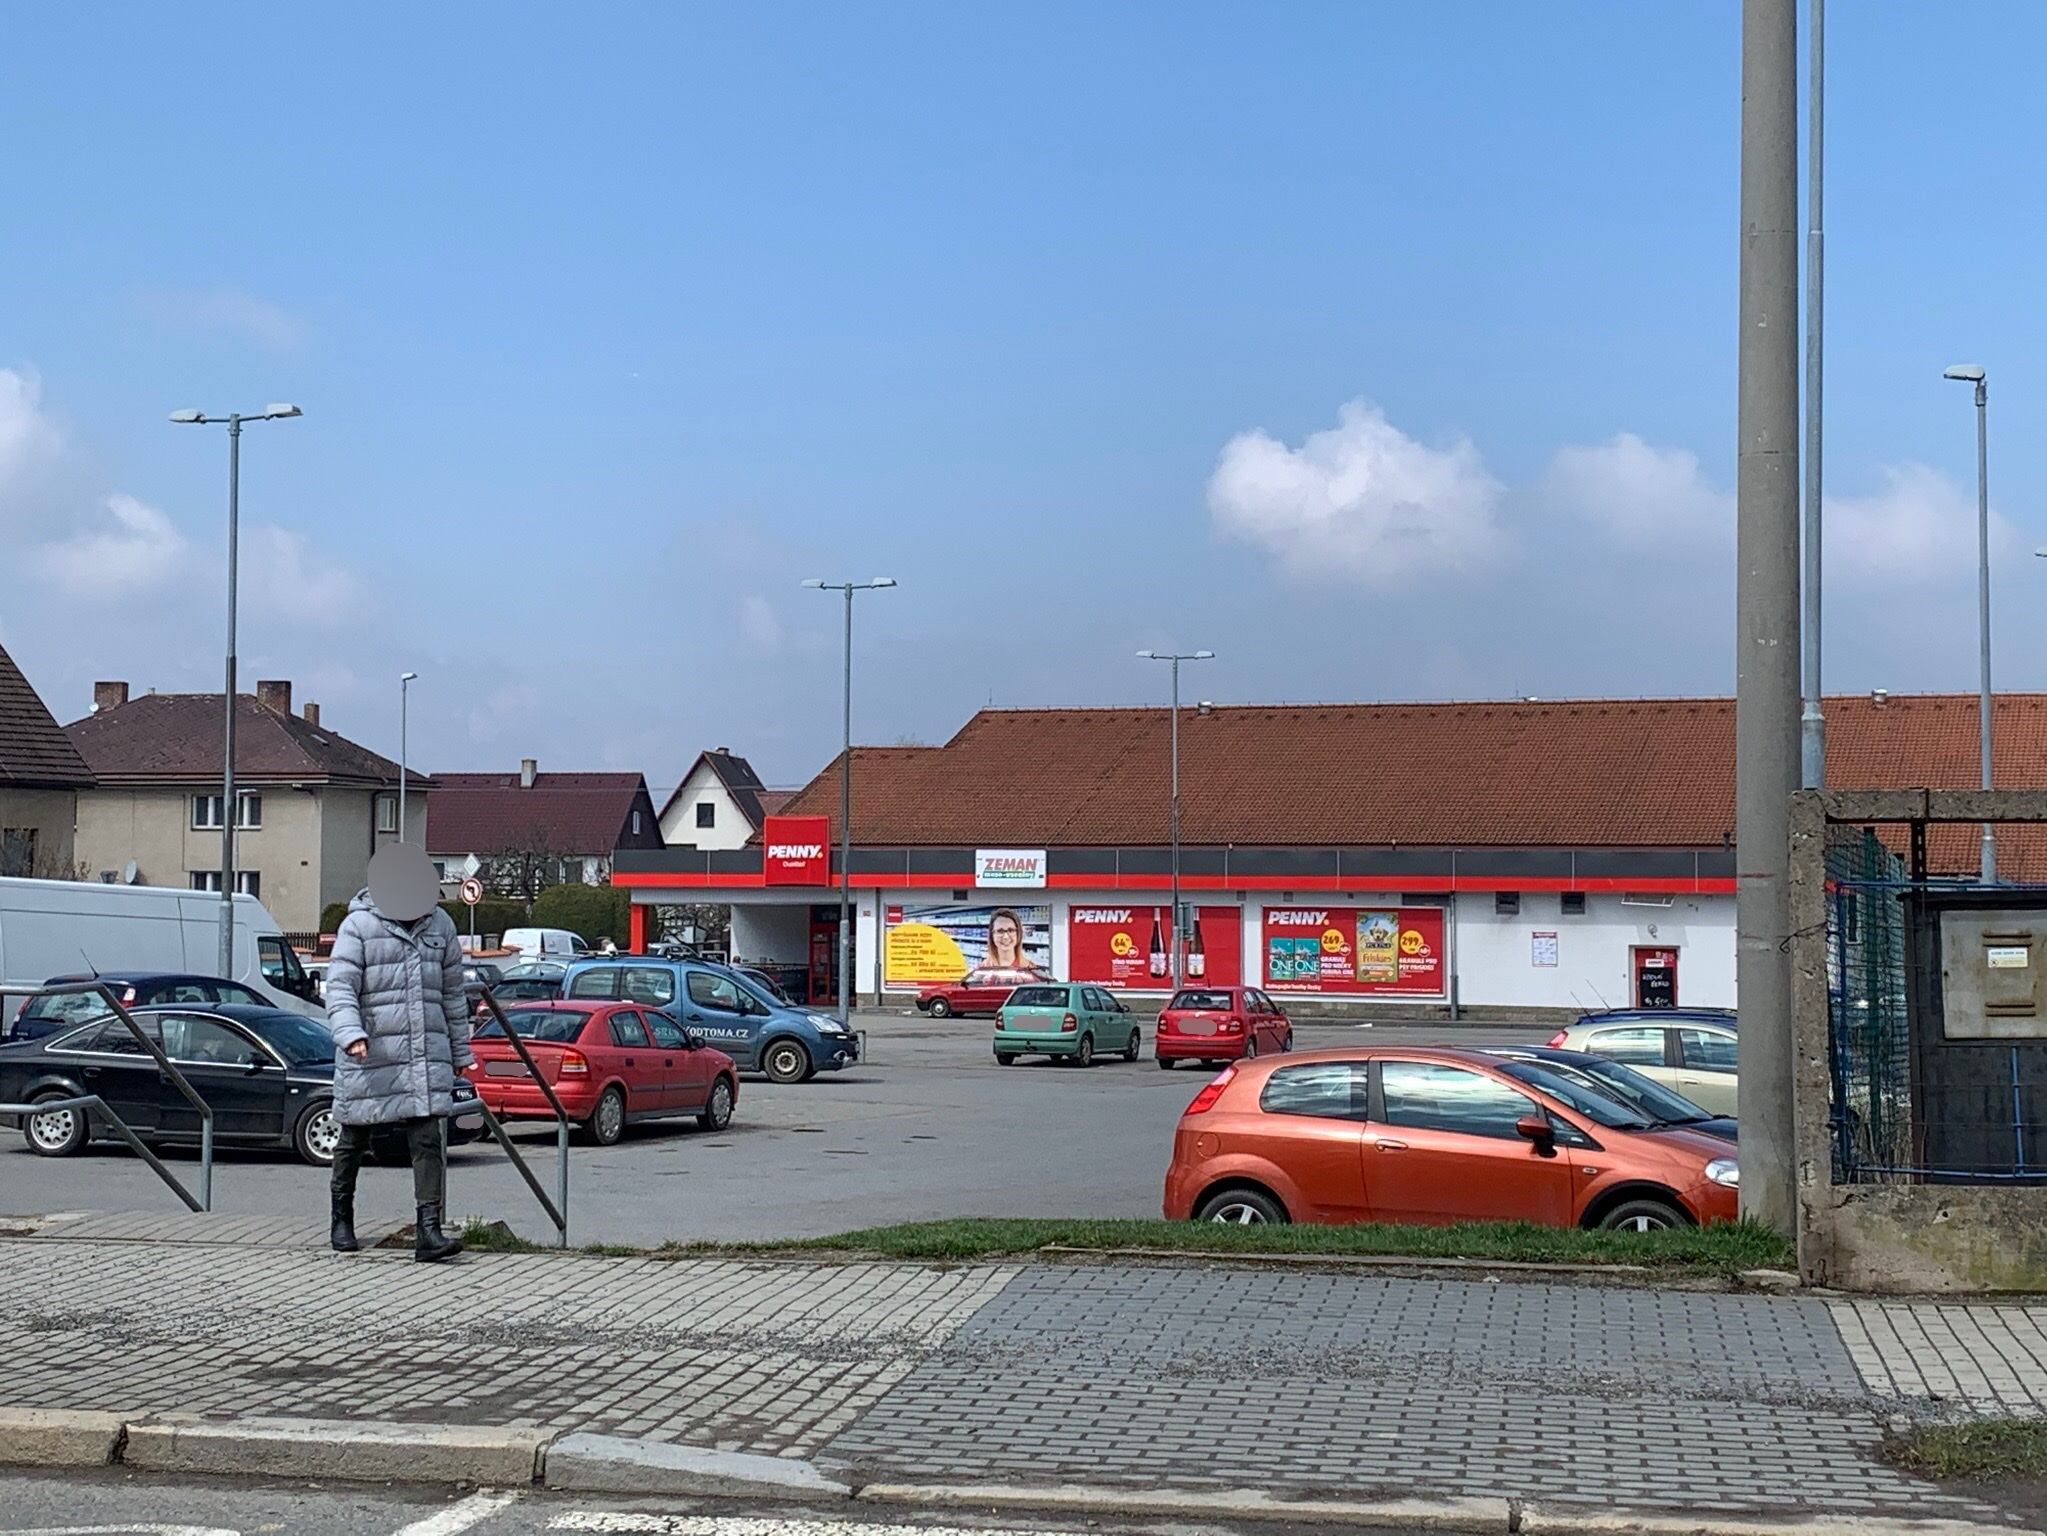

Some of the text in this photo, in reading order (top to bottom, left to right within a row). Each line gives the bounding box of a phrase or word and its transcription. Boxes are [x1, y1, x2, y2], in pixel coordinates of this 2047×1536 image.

[984, 858, 1038, 870] ZEMAN
[1270, 960, 1294, 971] ONE
[1295, 960, 1320, 972] ONE
